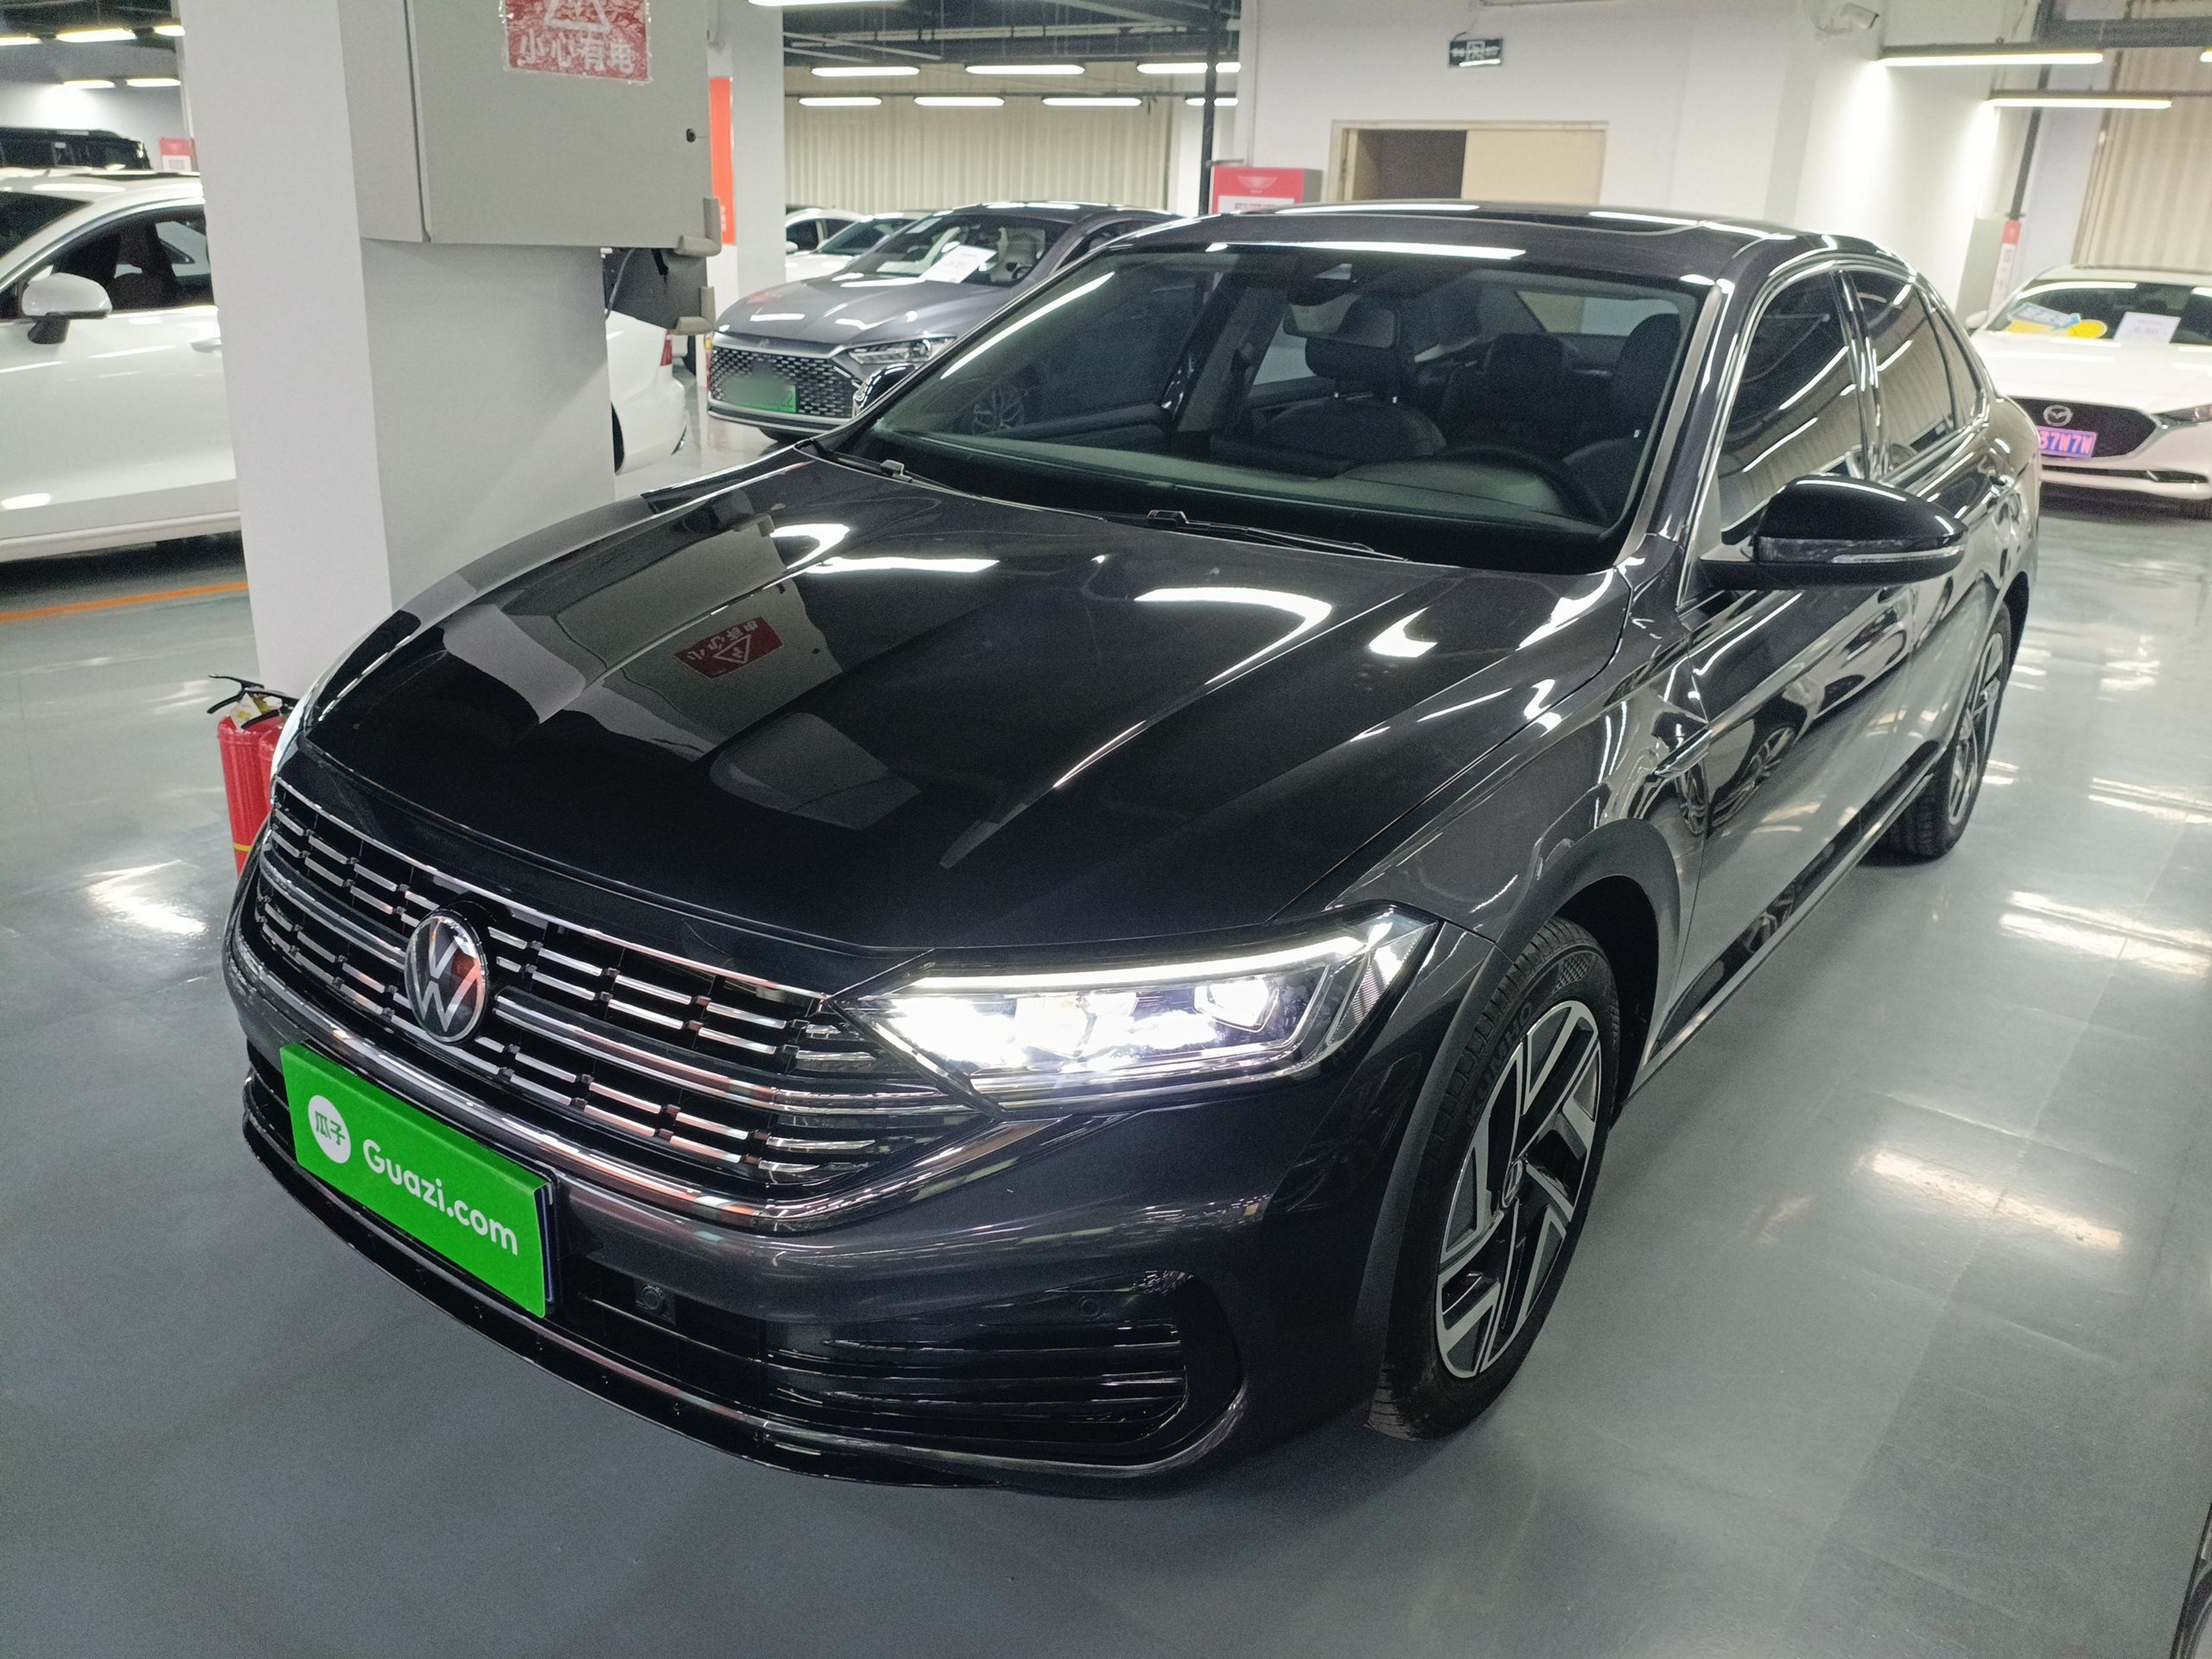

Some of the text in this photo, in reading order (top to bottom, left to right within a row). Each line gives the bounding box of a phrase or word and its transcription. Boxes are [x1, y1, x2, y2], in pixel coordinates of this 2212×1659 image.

[517, 29, 635, 74] 小心有电
[315, 1111, 345, 1146] 瓜子
[363, 1139, 518, 1256] Guazi.com
